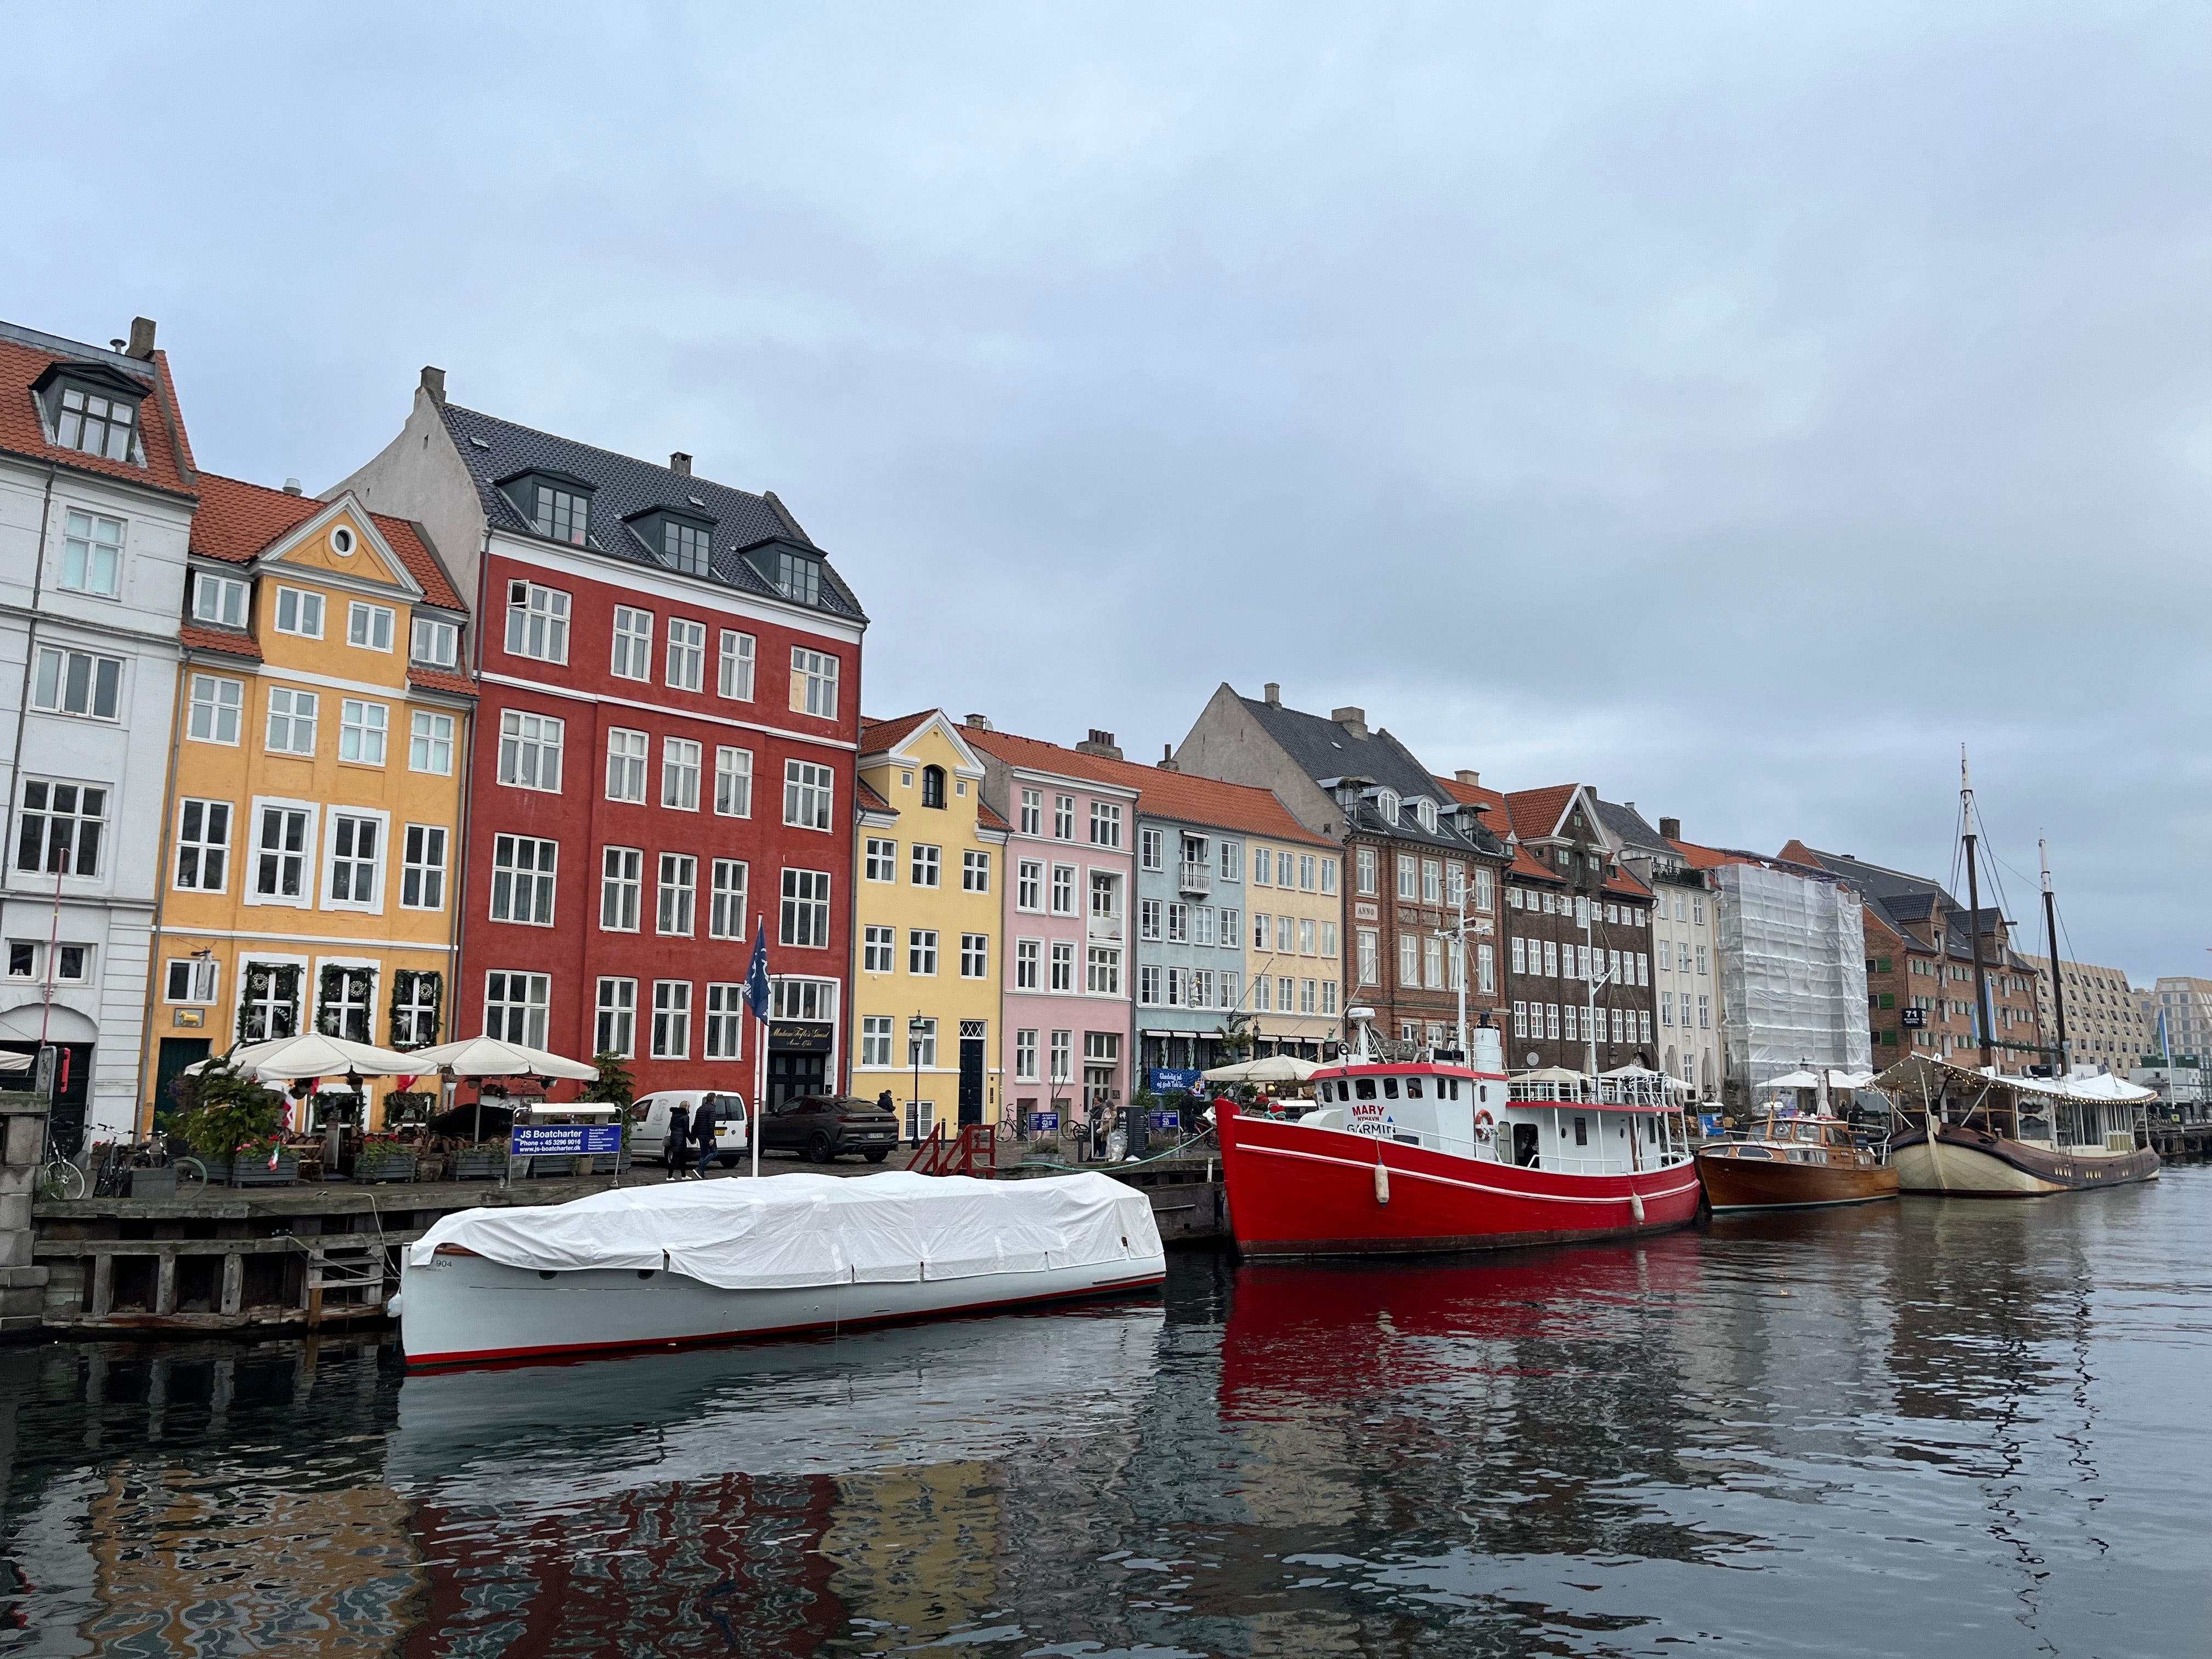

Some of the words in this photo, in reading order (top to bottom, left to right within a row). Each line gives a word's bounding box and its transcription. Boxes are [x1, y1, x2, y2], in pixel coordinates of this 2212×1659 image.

[1358, 907, 1374, 916] ANNO
[274, 1007, 289, 1022] PIZZA
[1352, 1105, 1385, 1116] MARY
[1347, 1124, 1396, 1134] GARMIN
[520, 1130, 532, 1139] JS
[533, 1130, 583, 1138] Boatcharter
